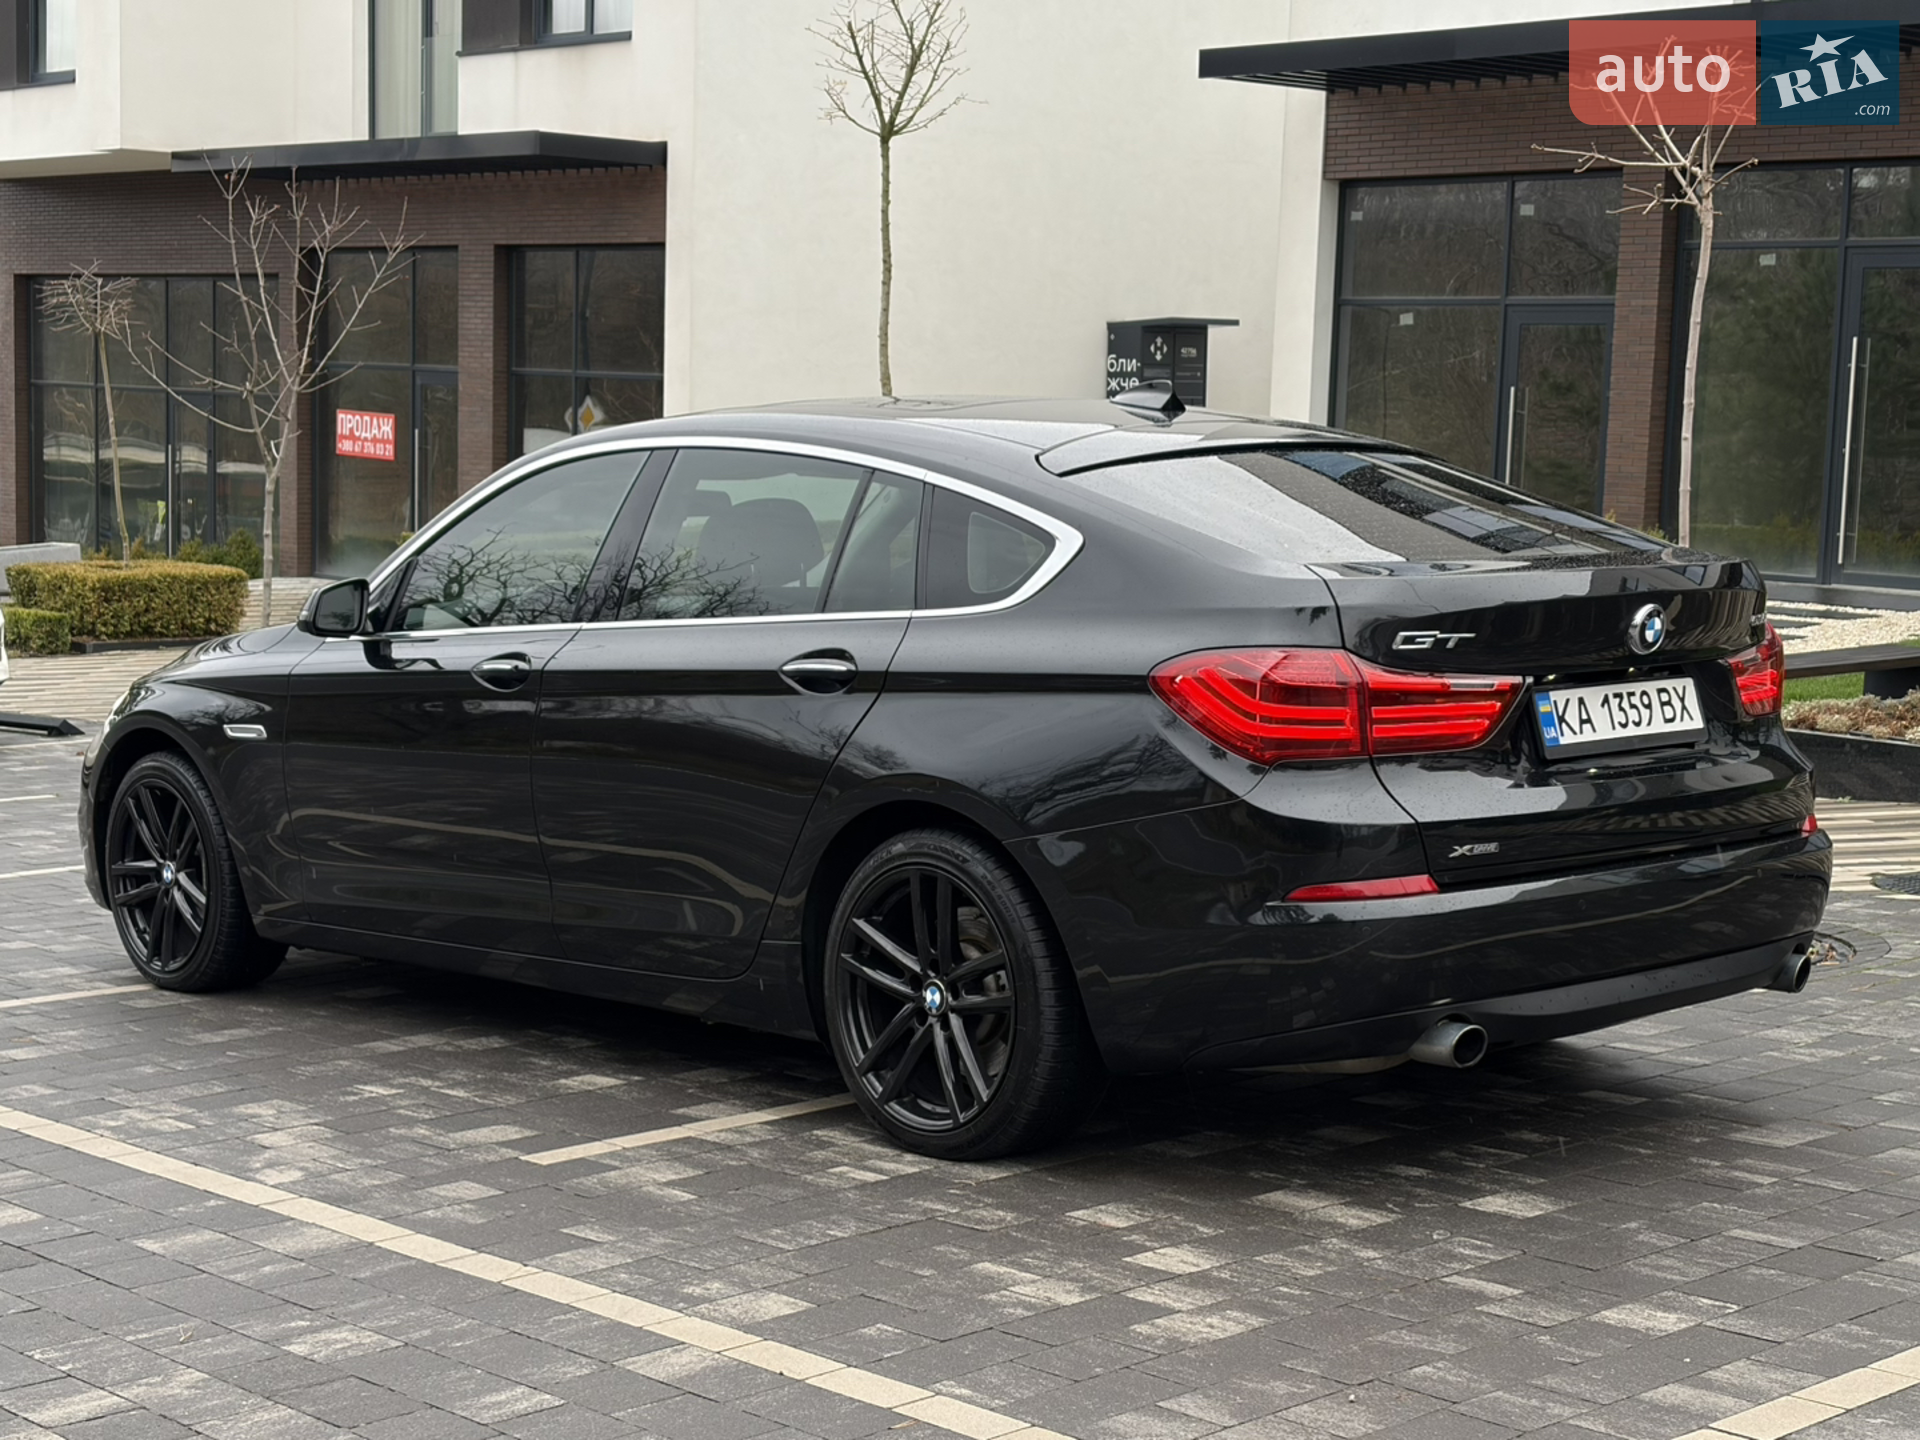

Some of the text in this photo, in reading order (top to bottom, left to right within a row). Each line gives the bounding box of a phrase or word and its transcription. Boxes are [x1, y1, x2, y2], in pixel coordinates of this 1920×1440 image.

[338, 413, 393, 440] ПРОДАЖ
[1392, 630, 1477, 650] GT
[1543, 684, 1695, 739] UA KA 1359 BX
